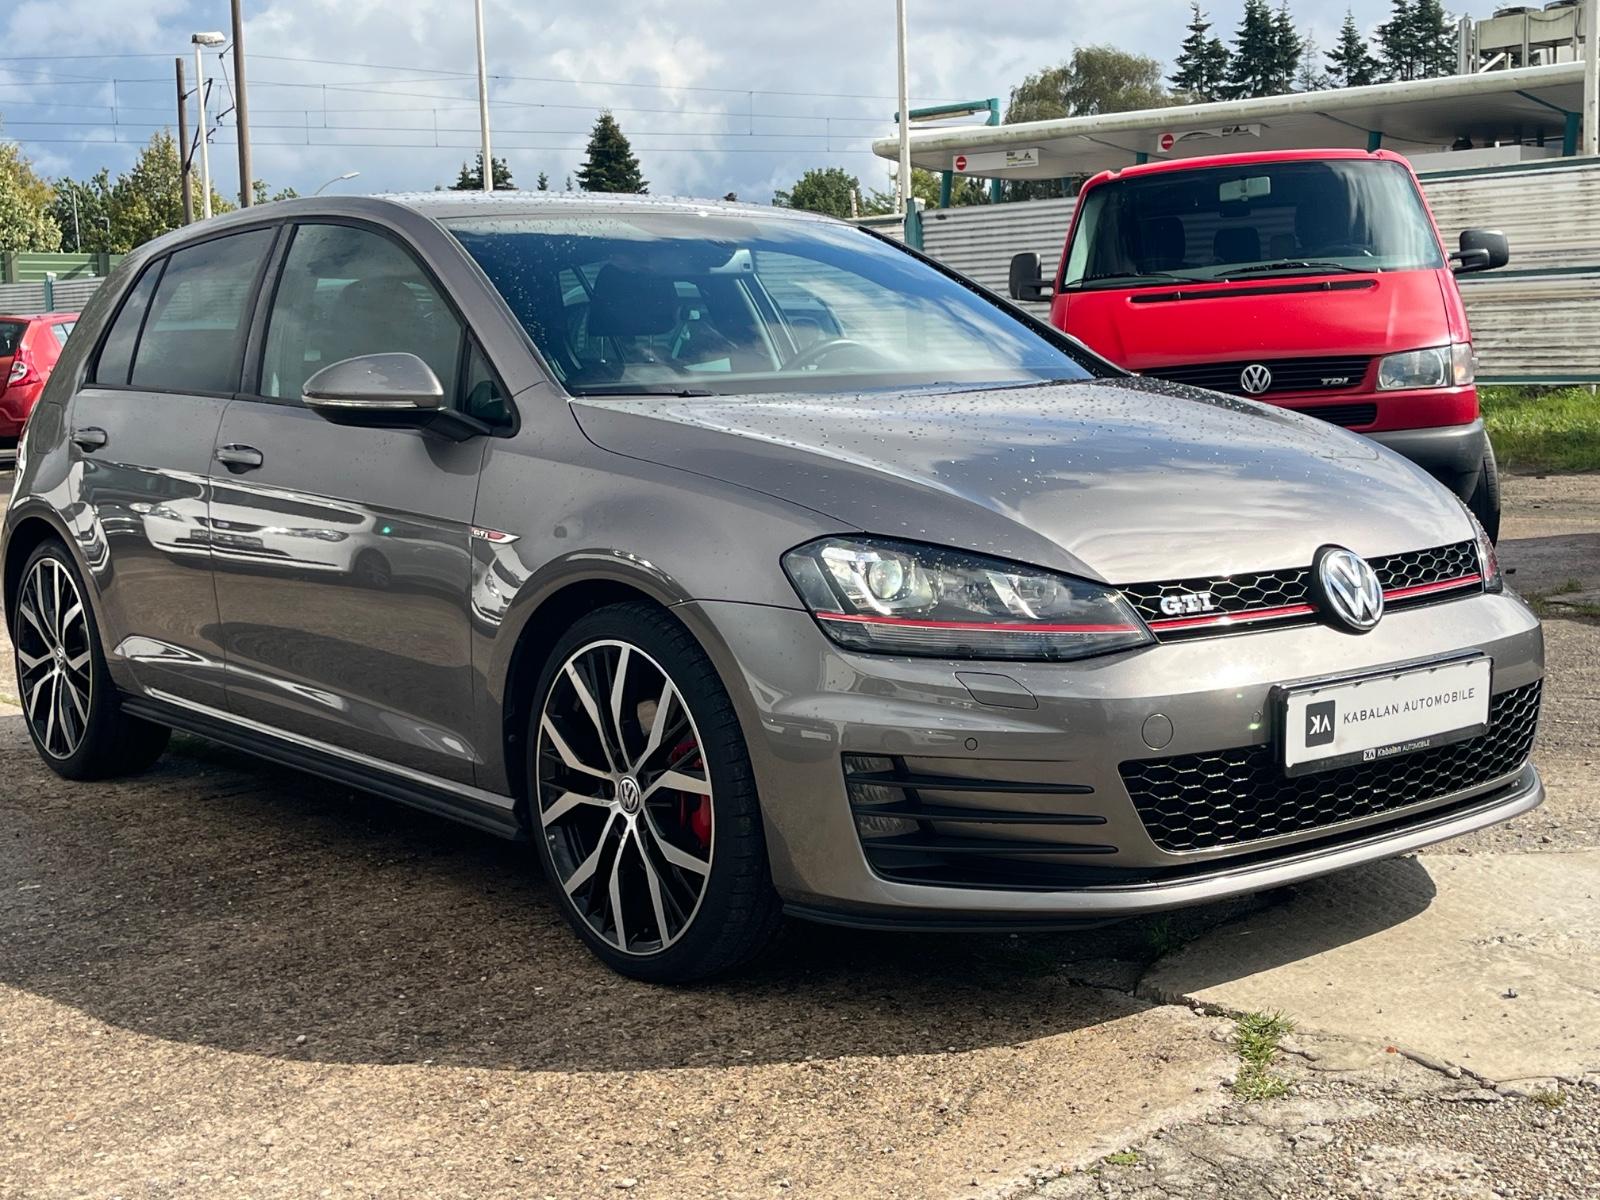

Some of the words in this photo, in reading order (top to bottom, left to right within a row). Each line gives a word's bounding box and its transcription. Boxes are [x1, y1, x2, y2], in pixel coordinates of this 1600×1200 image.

[1320, 376, 1349, 386] TDI
[1160, 592, 1216, 616] GTI
[1319, 549, 1384, 631] VW
[1343, 704, 1399, 725] KABALAN
[1403, 687, 1476, 713] AUTOMOBILE
